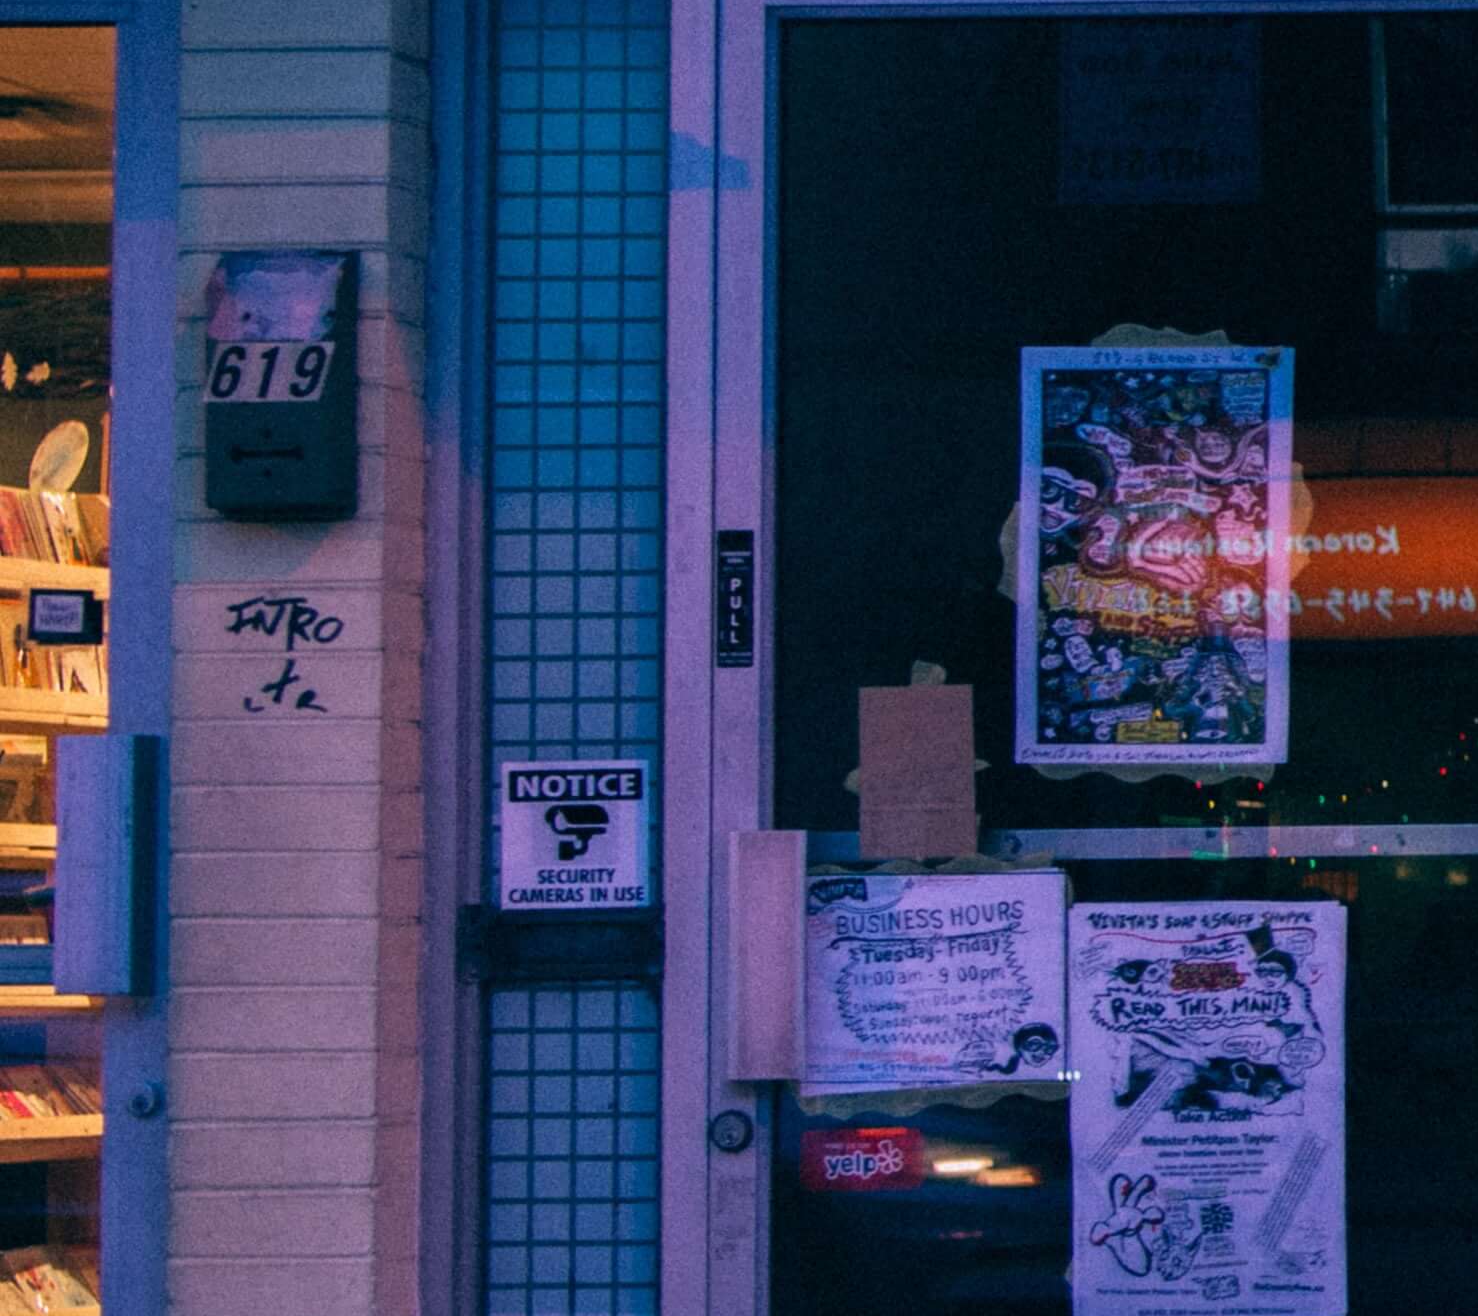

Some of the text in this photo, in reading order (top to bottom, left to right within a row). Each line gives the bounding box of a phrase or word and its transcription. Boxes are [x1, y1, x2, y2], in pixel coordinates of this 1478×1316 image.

[210, 345, 328, 398] 619
[730, 578, 742, 643] PULL
[517, 774, 636, 797] NOTICE
[537, 868, 616, 884] SECURITY
[509, 886, 645, 903] CAMERAS IN USE
[836, 900, 1025, 935] BUSINESS HOURS
[949, 936, 1000, 957] Friday
[1111, 997, 1165, 1023] READ
[824, 1150, 878, 1180] yelp
